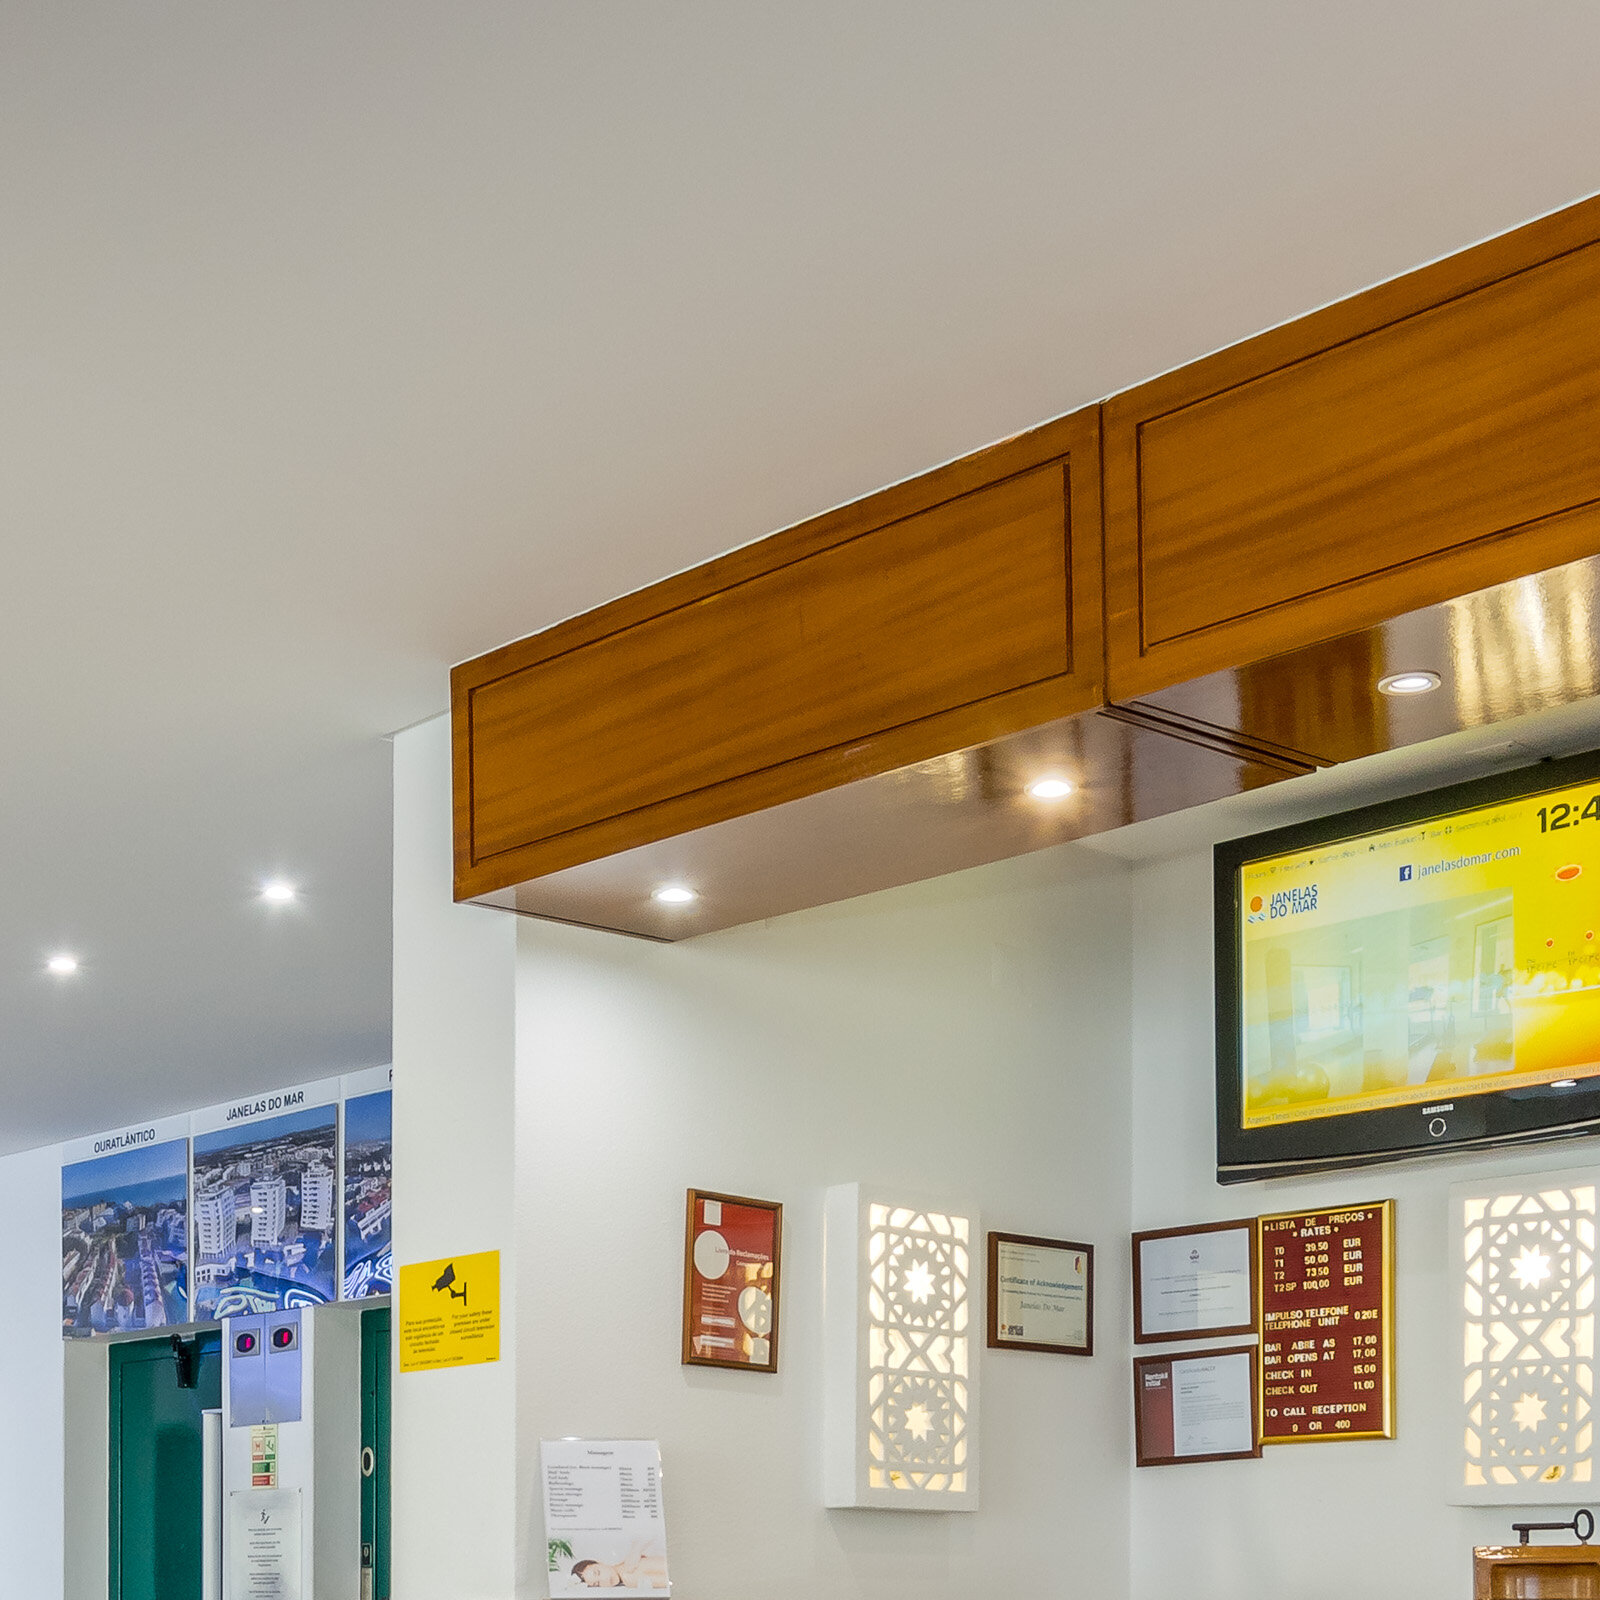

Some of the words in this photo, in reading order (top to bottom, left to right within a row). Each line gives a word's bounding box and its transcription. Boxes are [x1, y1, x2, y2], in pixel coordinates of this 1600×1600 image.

[1417, 846, 1520, 880] janelasdomar.com
[1270, 884, 1318, 907] JANELAS
[1270, 903, 1287, 919] DO
[1291, 897, 1318, 914] MAR
[226, 1100, 266, 1121] JANELAS
[268, 1098, 282, 1110] DO
[283, 1091, 304, 1107] MAR
[94, 1128, 155, 1153] OURATLÂNTICO
[1270, 1221, 1296, 1231] LISTA
[1305, 1217, 1316, 1227] DE
[1329, 1211, 1364, 1224] PREÇOS
[1301, 1226, 1331, 1237] RATES
[1343, 1237, 1361, 1248] EUR
[1274, 1259, 1284, 1268] T1
[1343, 1250, 1362, 1260] EUR
[1274, 1272, 1285, 1280] T2
[1344, 1263, 1363, 1273] EUR
[1037, 1280, 1083, 1291] Acknowledgement
[1344, 1275, 1363, 1286] EUR
[1265, 1310, 1303, 1321] IMPULSO
[1305, 1305, 1349, 1318] TELEFONE
[1265, 1319, 1311, 1331] TELEPHONE
[1318, 1316, 1340, 1326] UNIT
[1264, 1343, 1281, 1352] BAR
[1291, 1340, 1315, 1350] ABRE
[1323, 1339, 1336, 1348] AS
[1264, 1356, 1281, 1365] BAR
[1287, 1353, 1318, 1363] OPENS
[1323, 1351, 1335, 1360] AT
[1265, 1370, 1294, 1380] CHECK
[1301, 1369, 1312, 1378] IN
[1265, 1386, 1294, 1395] CHECK
[1300, 1384, 1318, 1394] OUT
[1265, 1409, 1278, 1417] TO
[1283, 1407, 1306, 1416] CALL
[1312, 1403, 1367, 1415] RECEPTION
[1309, 1421, 1322, 1430] OR
